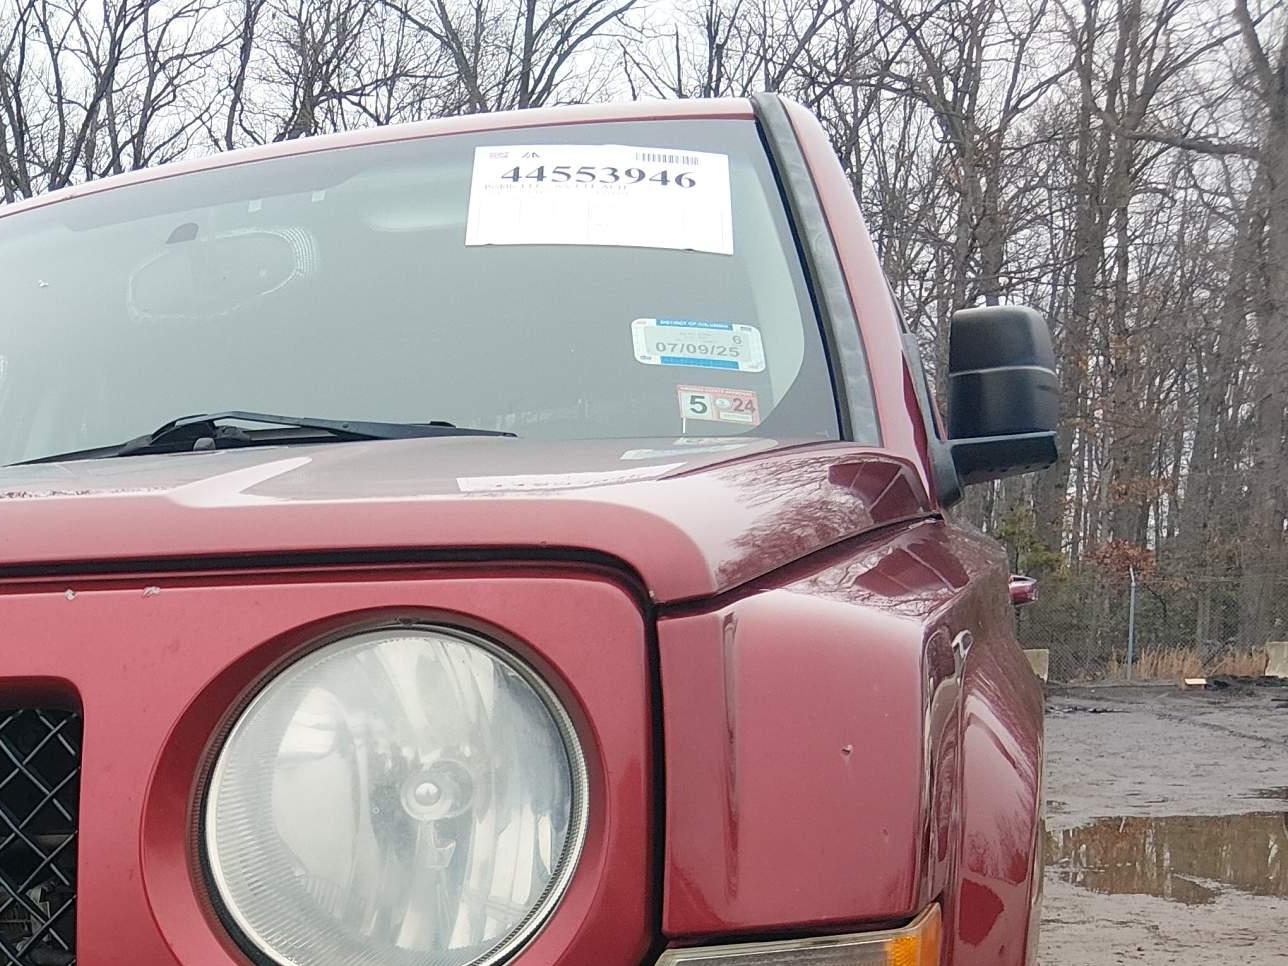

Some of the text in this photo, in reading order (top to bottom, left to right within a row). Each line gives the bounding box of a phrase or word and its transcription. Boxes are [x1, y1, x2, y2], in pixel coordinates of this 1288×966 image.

[500, 165, 697, 189] 44553946
[655, 341, 741, 358] 07/09/25
[732, 335, 743, 345] 6
[688, 394, 756, 415] 5 24
